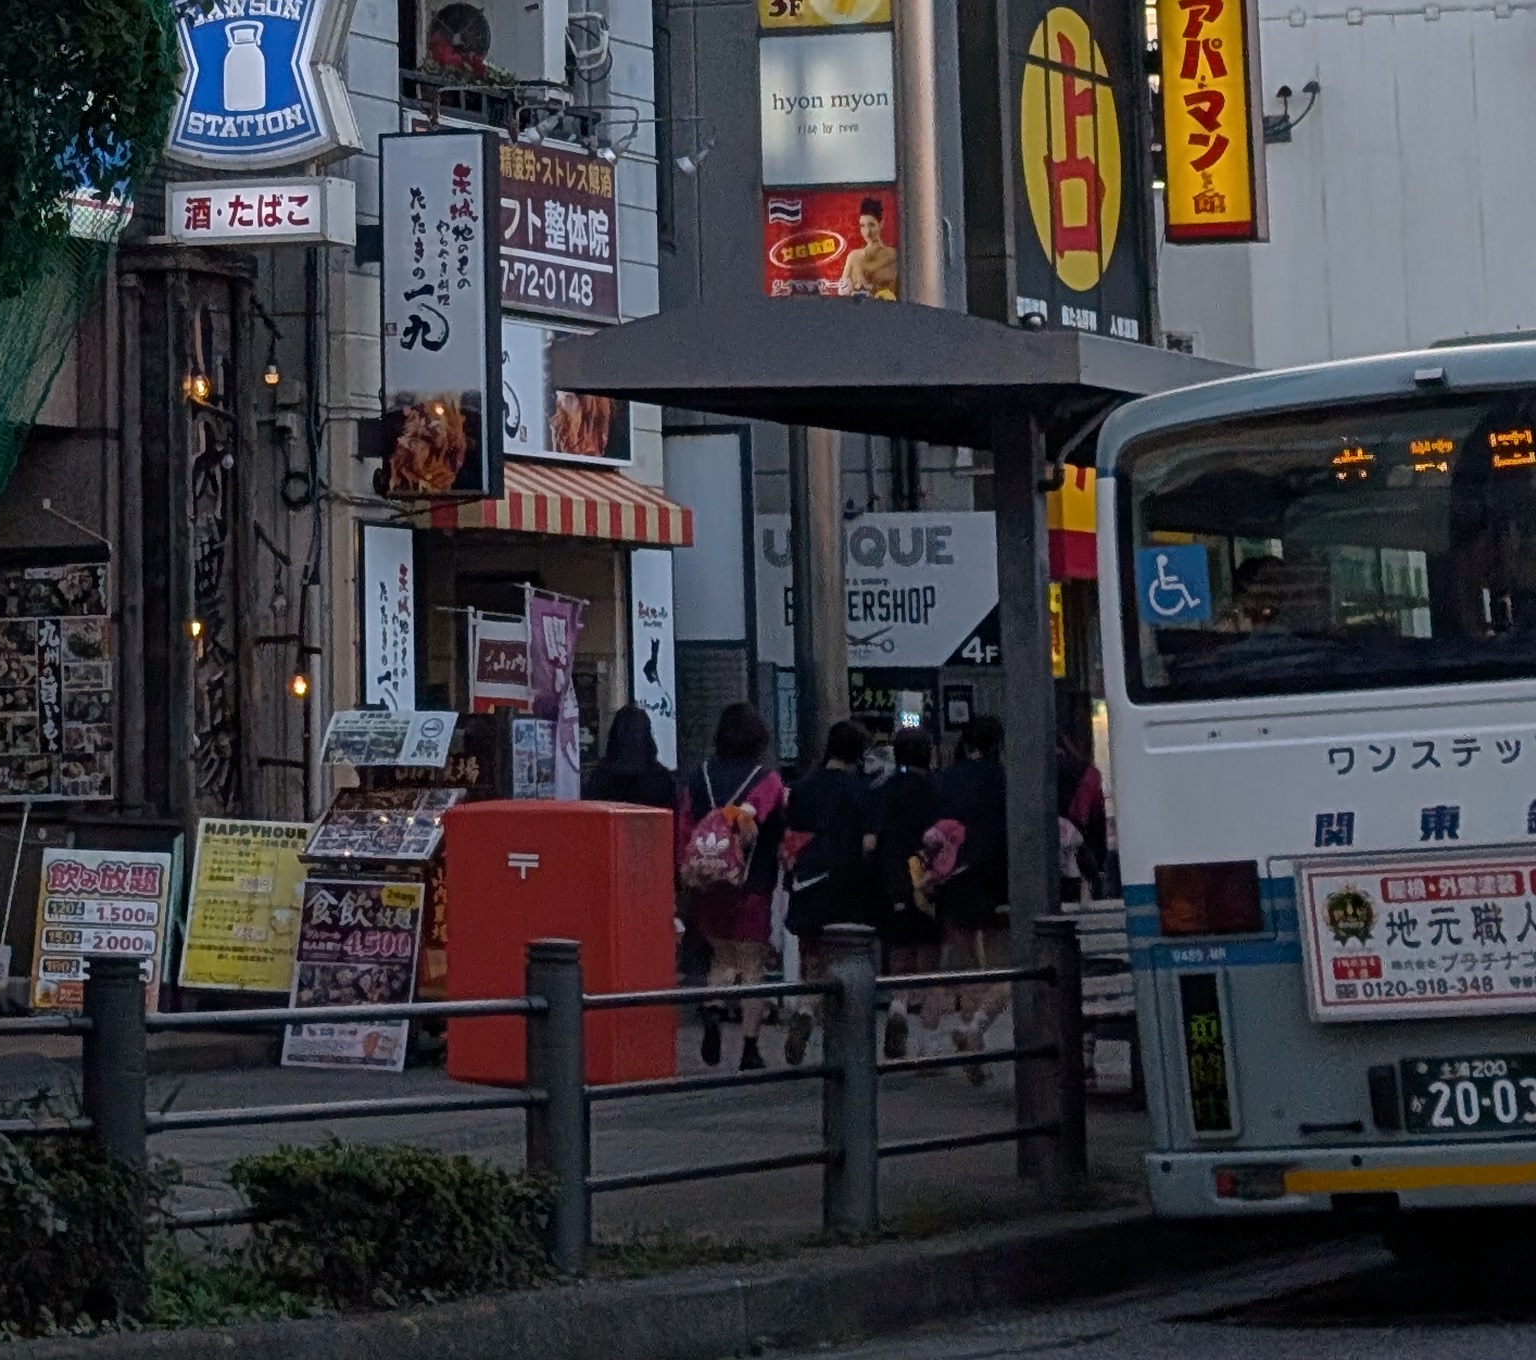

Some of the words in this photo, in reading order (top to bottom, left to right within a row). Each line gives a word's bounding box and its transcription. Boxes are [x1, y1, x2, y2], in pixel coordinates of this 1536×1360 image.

[186, 103, 306, 138] STATION
[771, 92, 824, 115] hyon
[830, 91, 889, 113] myon
[1042, 30, 1107, 260] 占
[184, 193, 311, 231] 酒・たばこ
[449, 162, 479, 291] 茨城地のもの
[500, 196, 610, 259] フト整体院
[762, 525, 955, 569] UQUE
[784, 584, 937, 627] BERSHOP
[961, 635, 999, 664] 4F
[1328, 734, 1522, 775] ワンステッ
[47, 860, 161, 896] 飲み放題
